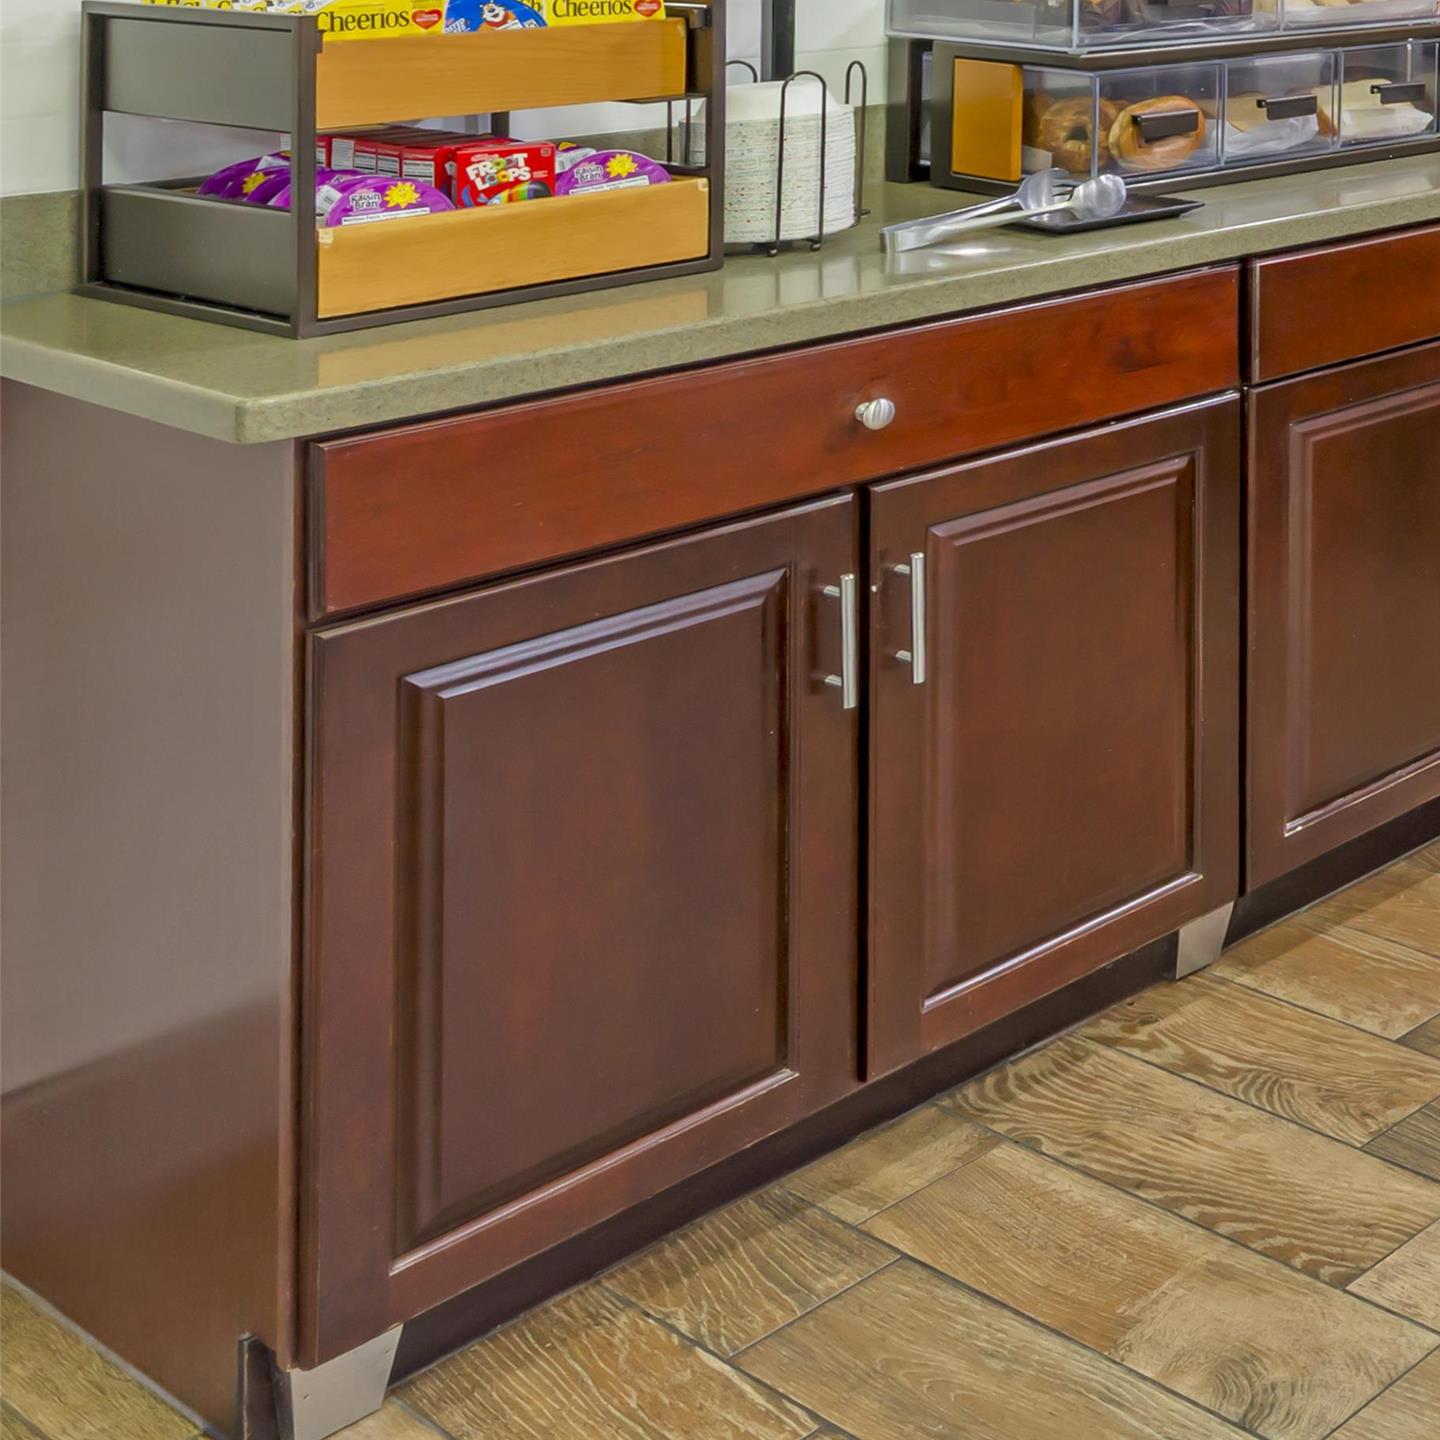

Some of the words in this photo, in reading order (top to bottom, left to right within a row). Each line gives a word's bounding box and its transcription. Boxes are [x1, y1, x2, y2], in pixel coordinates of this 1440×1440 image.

[315, 10, 410, 32] Cheerios
[465, 152, 528, 180] FROOT
[474, 166, 531, 191] LOOPS
